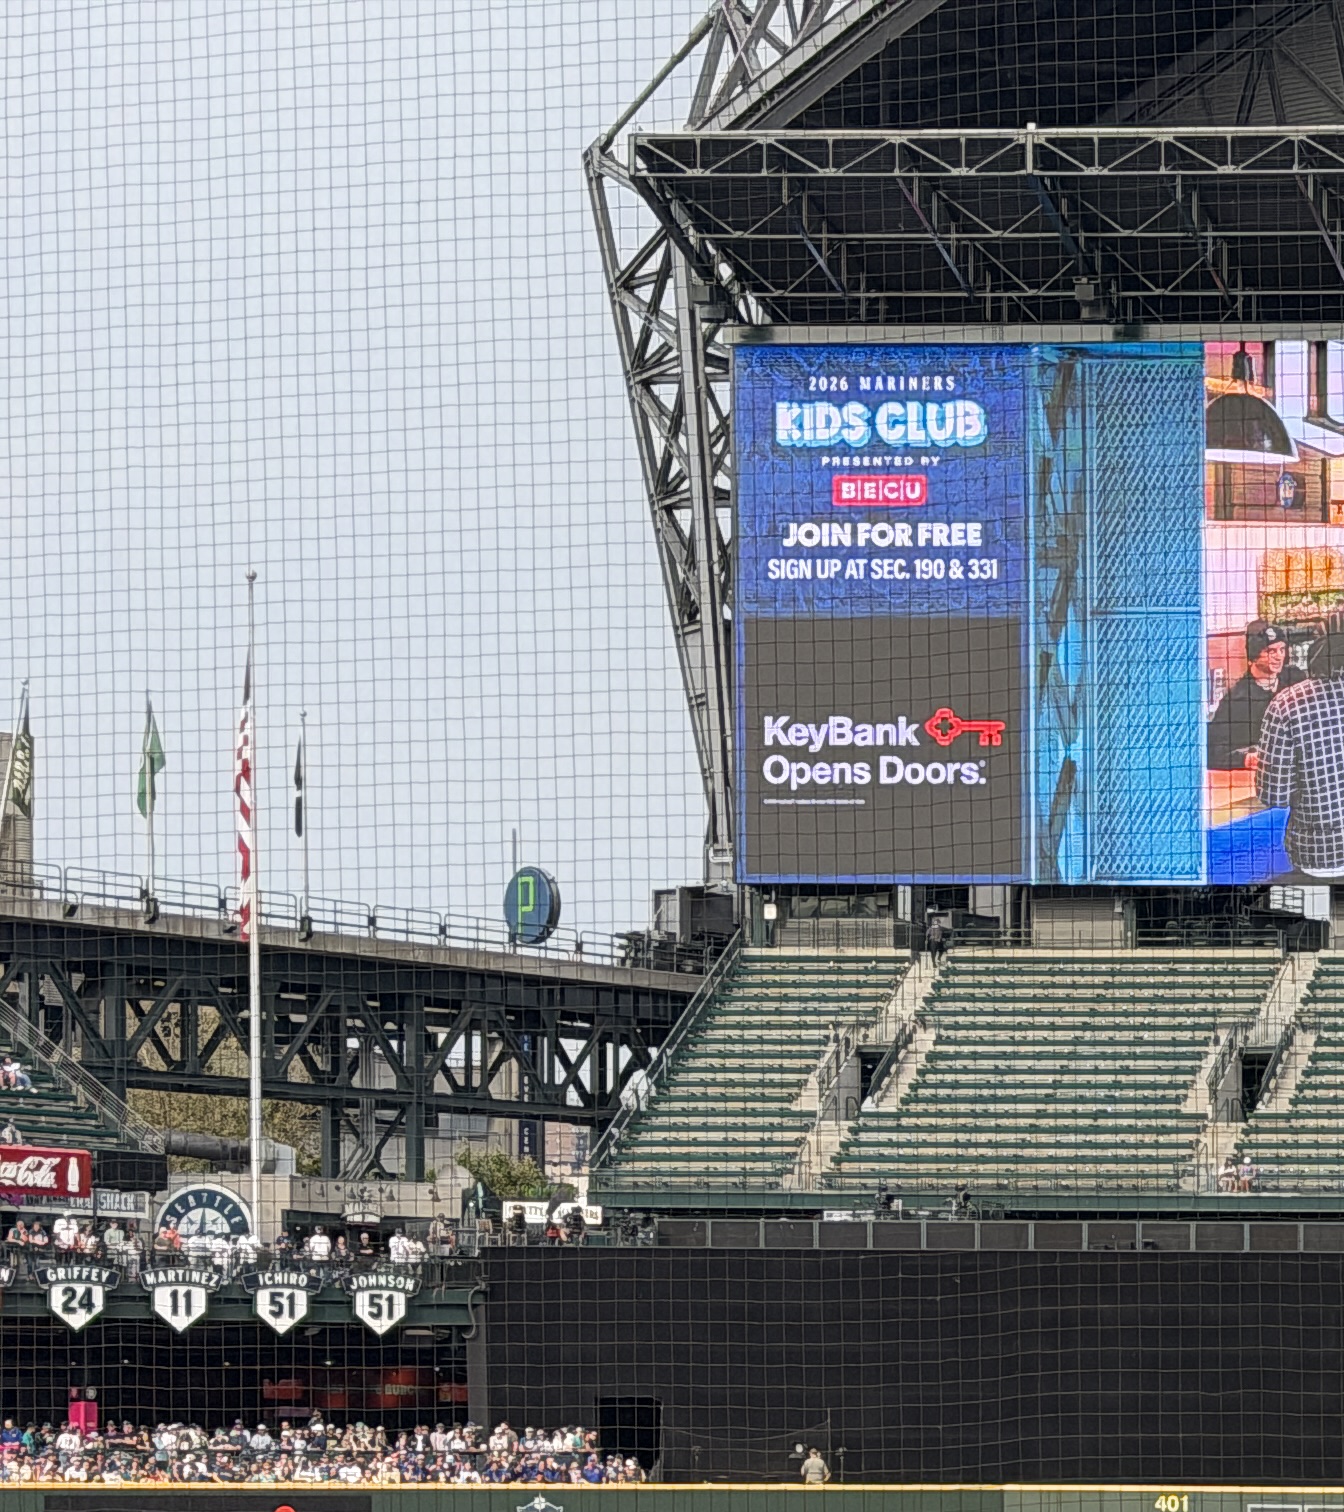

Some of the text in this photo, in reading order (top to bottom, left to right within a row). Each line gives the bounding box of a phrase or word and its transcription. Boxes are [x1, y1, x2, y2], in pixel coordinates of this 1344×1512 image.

[808, 375, 956, 392] 2026 MARINERS
[775, 400, 987, 447] KIDS CLUB
[821, 456, 940, 468] PRESENTED BY
[782, 522, 982, 548] JOIN FOR FREE
[768, 559, 998, 580] SIGN UP AT SEC. 190 & 331
[763, 717, 919, 753] KeyBank
[763, 757, 871, 790] Opens
[100, 1193, 135, 1211] SHACK
[165, 1192, 245, 1226] SEATTLE
[46, 1267, 110, 1283] GRIFFEY
[145, 1268, 219, 1287] MARTINEZ
[258, 1273, 307, 1287] ICHIRO
[350, 1274, 415, 1292] JOHNSON
[61, 1286, 95, 1315] 24
[170, 1289, 192, 1317] 11
[268, 1292, 295, 1320] 51
[368, 1293, 395, 1320] 51
[1155, 1495, 1189, 1512] 401
